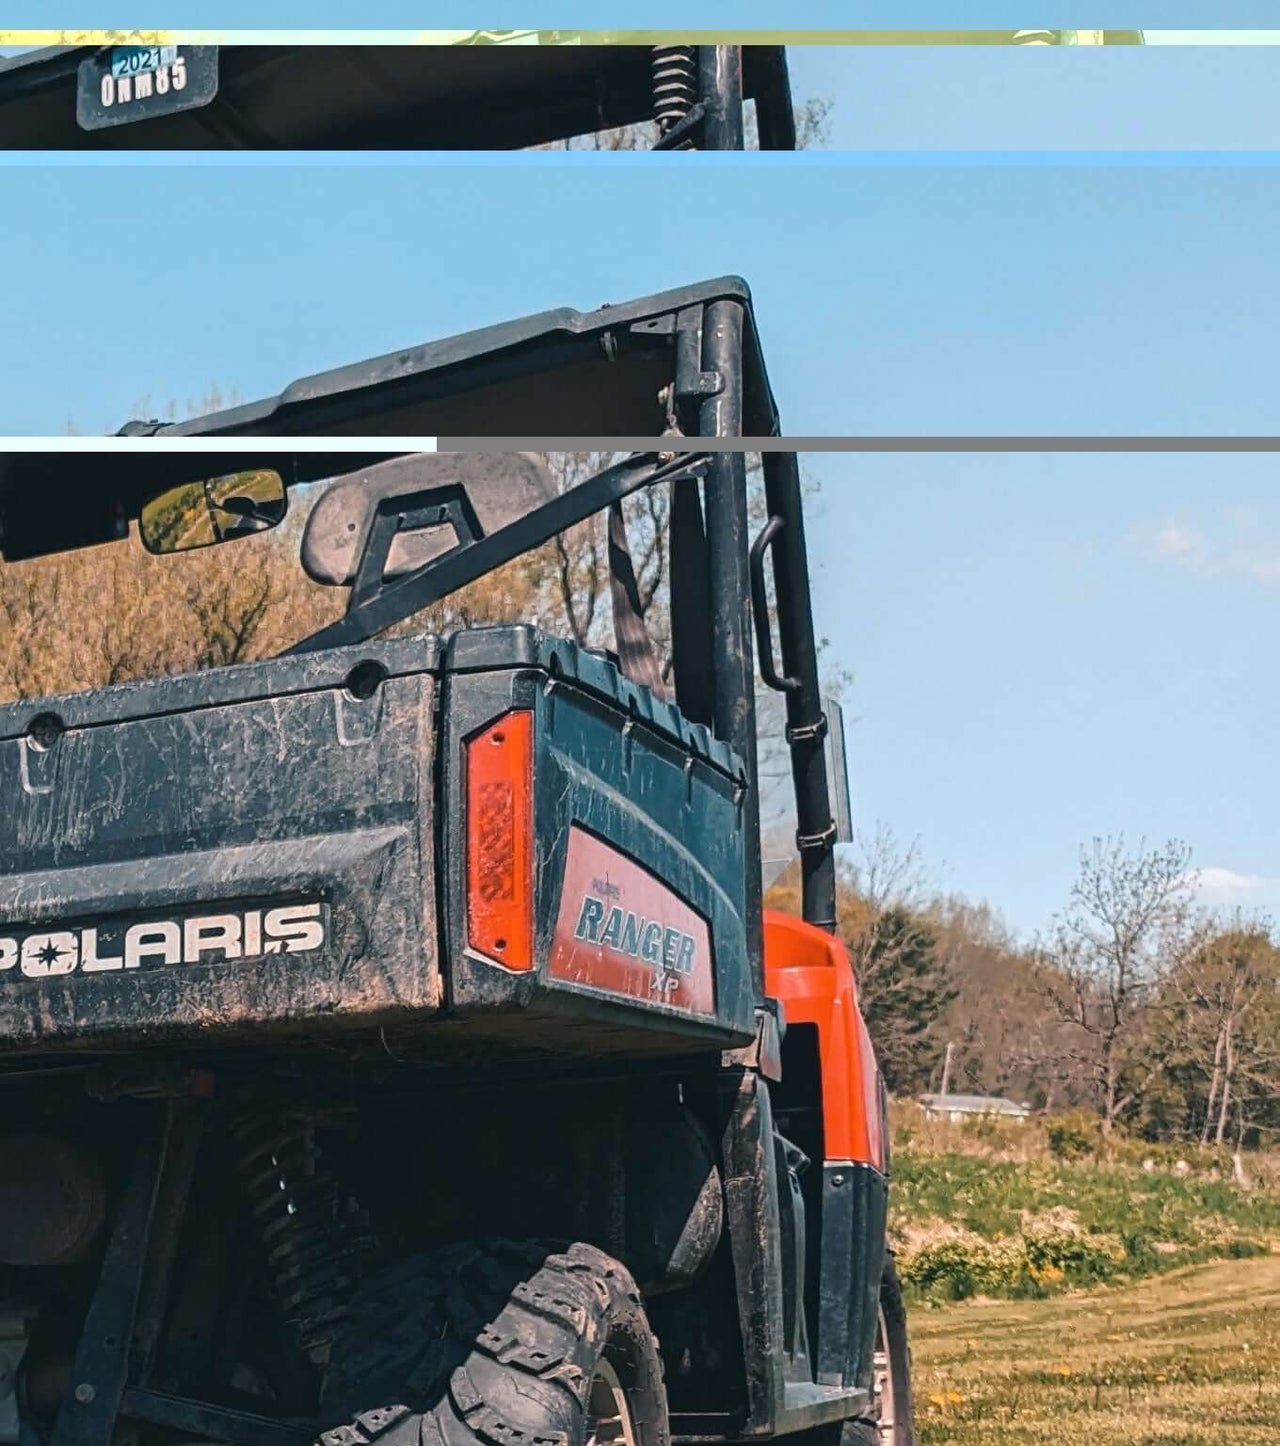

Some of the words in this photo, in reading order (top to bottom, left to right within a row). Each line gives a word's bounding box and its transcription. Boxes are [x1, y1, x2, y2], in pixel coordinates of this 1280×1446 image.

[119, 47, 161, 75] 2021
[574, 894, 696, 976] RANGER
[650, 971, 680, 994] XP
